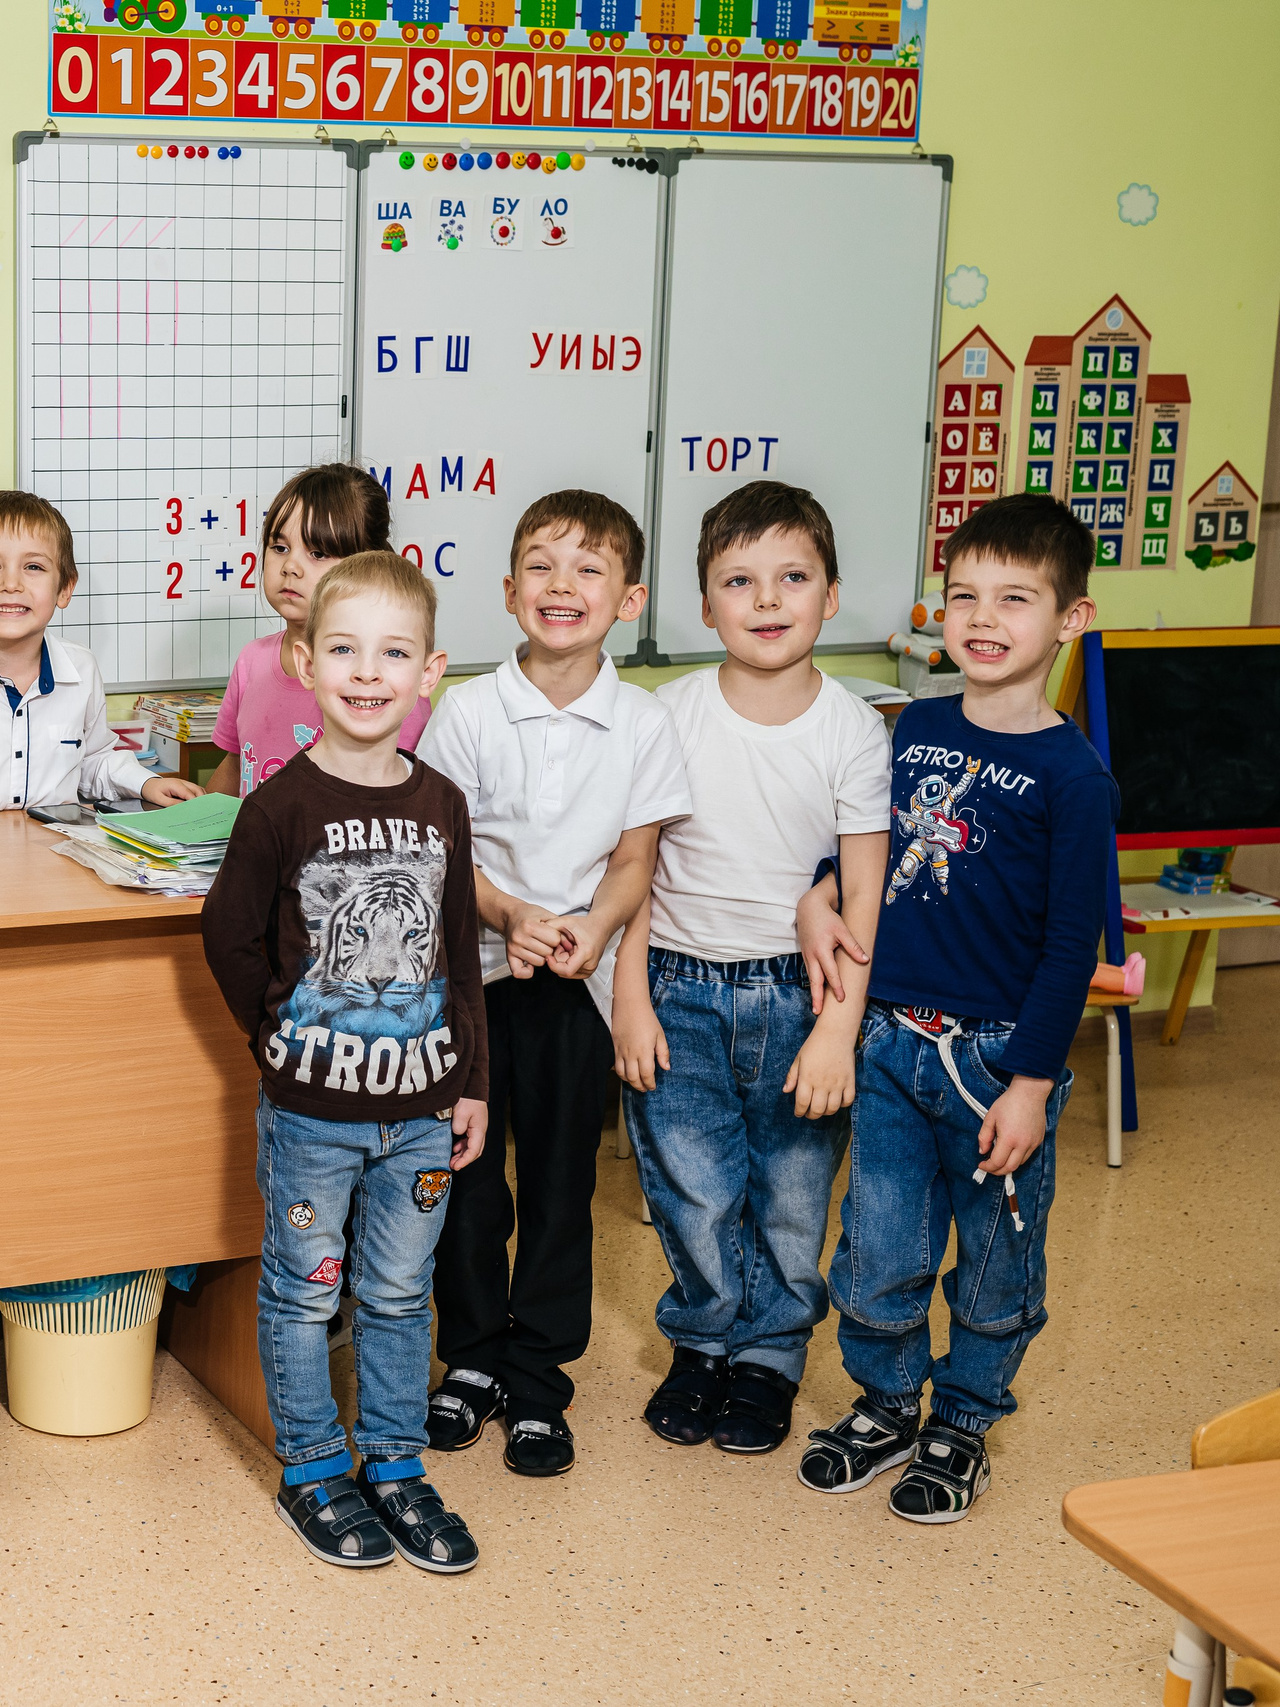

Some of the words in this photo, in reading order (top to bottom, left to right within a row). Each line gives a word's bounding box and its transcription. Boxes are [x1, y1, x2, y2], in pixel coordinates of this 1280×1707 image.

[58, 47, 92, 103] 0
[110, 48, 132, 105] 1
[150, 49, 184, 106] 2
[195, 50, 228, 107] 3
[237, 53, 274, 109] 4
[284, 54, 316, 110] 5
[326, 55, 360, 111] 6
[370, 57, 402, 112] 7
[412, 57, 445, 113] 8
[456, 59, 488, 115] 9
[495, 62, 532, 117] 10
[536, 64, 572, 118] 11
[577, 66, 613, 120] 12
[617, 67, 652, 121] 13
[656, 68, 691, 123] 14
[695, 70, 730, 123] 15
[733, 72, 768, 125] 16
[772, 73, 807, 126] 17
[809, 75, 842, 127] 18
[847, 76, 880, 128] 19
[881, 77, 916, 129] 20
[378, 202, 412, 221] ША
[439, 201, 467, 217] ВА
[493, 198, 519, 216] БУ
[540, 199, 568, 216] ЛО
[1087, 353, 1104, 372] П
[1118, 353, 1132, 372] Б
[948, 390, 966, 411] А
[980, 390, 997, 410] Я
[1036, 391, 1054, 410] Л
[1083, 391, 1102, 410] Ф
[1115, 391, 1129, 410] В
[947, 430, 963, 450] О
[978, 427, 993, 451] Ё
[1033, 429, 1052, 449] М
[1081, 429, 1096, 448] К
[1112, 429, 1126, 448] Г
[1156, 428, 1172, 447] Х
[682, 436, 779, 473] ТОРТ
[945, 469, 961, 488] У
[972, 468, 994, 488] Ю
[1030, 468, 1048, 487] Н
[1079, 467, 1094, 486] Т
[1107, 465, 1123, 486] Д
[1153, 465, 1170, 485] Ц
[938, 507, 961, 527] Ы
[1073, 505, 1094, 523] Ш
[1100, 504, 1123, 522] Ж
[1152, 503, 1165, 521] Ч
[1199, 518, 1214, 536] Ъ
[1229, 517, 1242, 535] Ь
[1102, 541, 1116, 560] З
[1143, 539, 1165, 559] Щ
[897, 744, 964, 769] ASTRO
[981, 762, 1035, 796] NUT
[324, 818, 421, 854] BRAVE
[426, 825, 445, 855] &
[265, 1018, 458, 1095] STRONG
